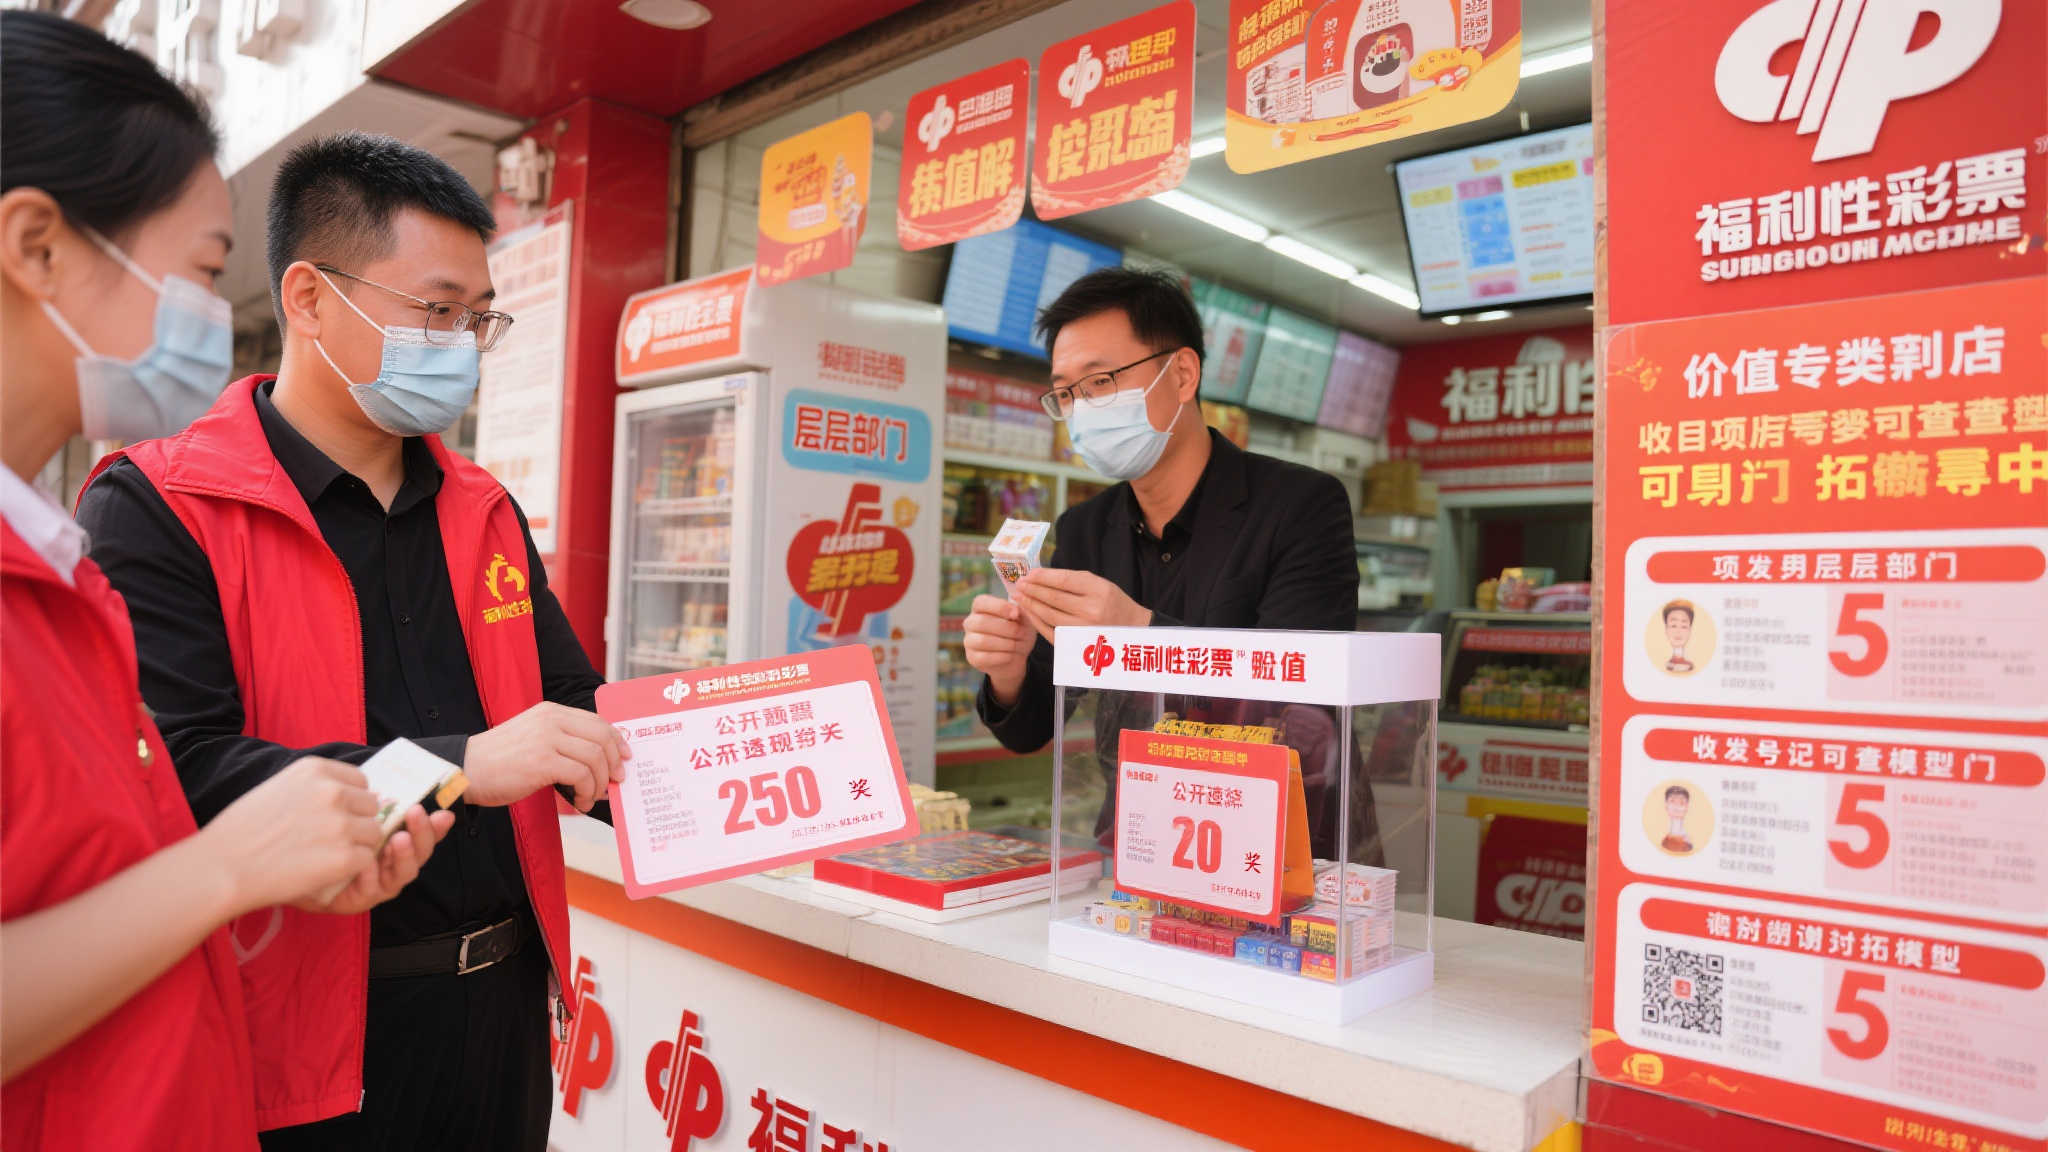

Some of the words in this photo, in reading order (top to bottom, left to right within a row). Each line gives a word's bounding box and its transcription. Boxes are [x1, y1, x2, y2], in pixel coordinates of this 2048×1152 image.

[1695, 148, 2026, 257] 福利性彩票
[795, 404, 908, 462] 层层部门
[1122, 643, 1233, 677] 福利性彩票
[1828, 593, 1889, 677] 5
[1693, 735, 1997, 782] 收发号记可查模型门
[718, 766, 821, 835] 250
[1827, 782, 1891, 869] 5
[1172, 816, 1222, 873] 20
[1826, 970, 1889, 1060] 5
